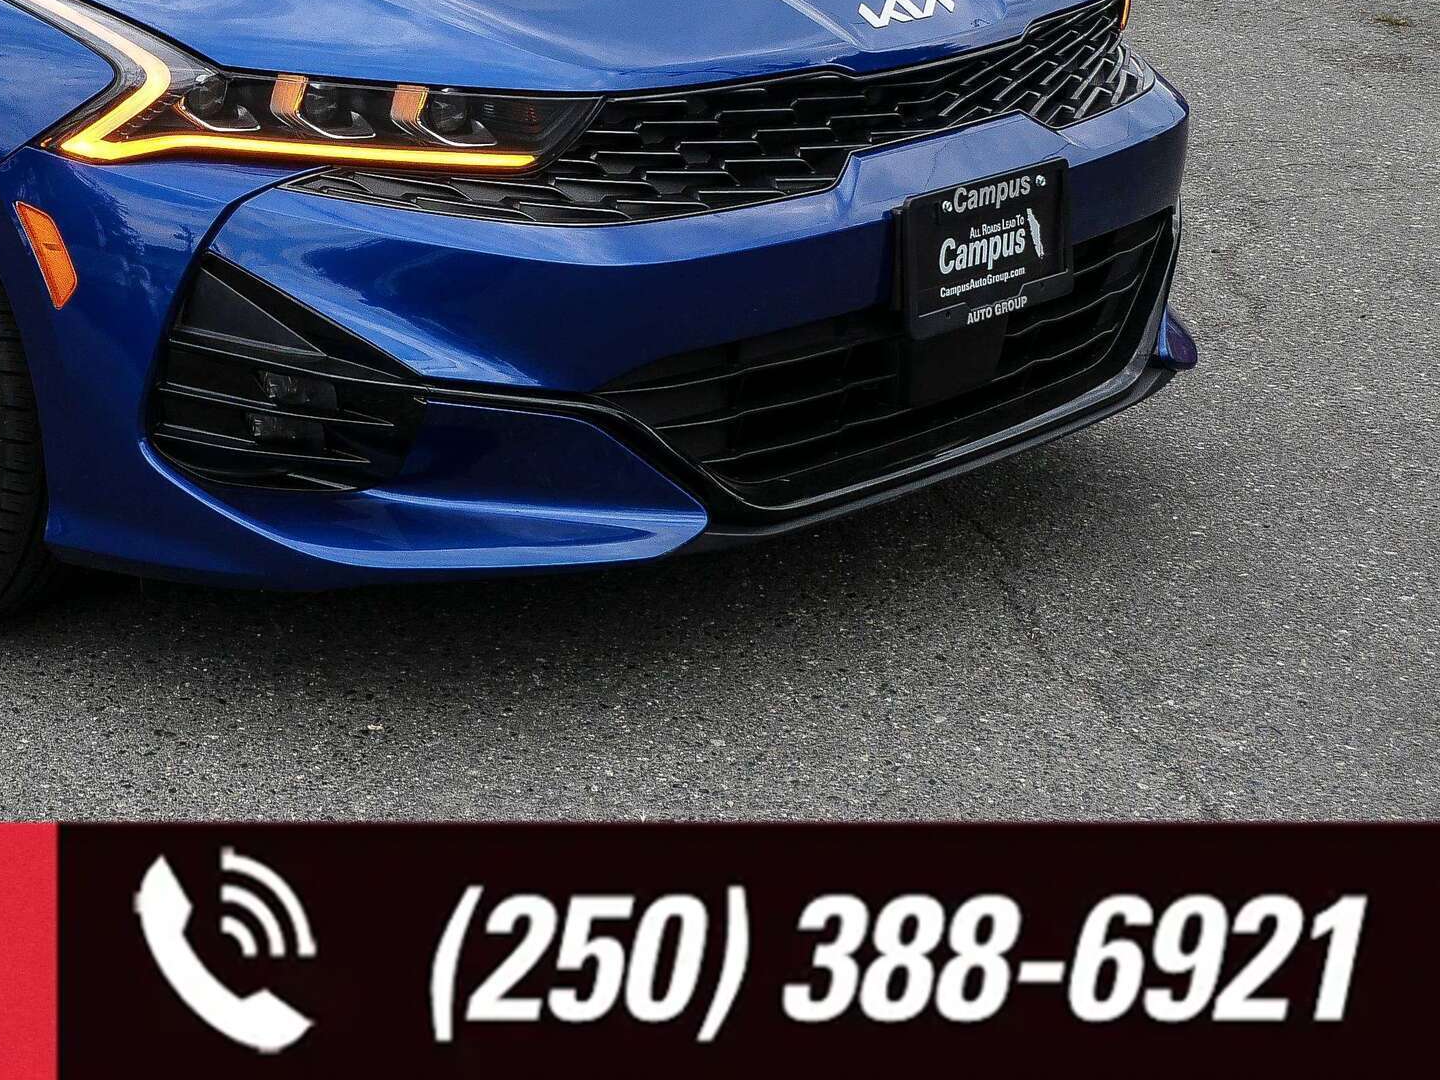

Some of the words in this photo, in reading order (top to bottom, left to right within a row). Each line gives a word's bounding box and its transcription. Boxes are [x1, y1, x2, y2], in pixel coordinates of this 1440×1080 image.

[953, 175, 1031, 214] Campus
[939, 228, 1027, 275] Campus
[940, 266, 1026, 298] CampusAutoGroup.com
[966, 306, 993, 325] AUTO
[994, 295, 1028, 316] GROUP
